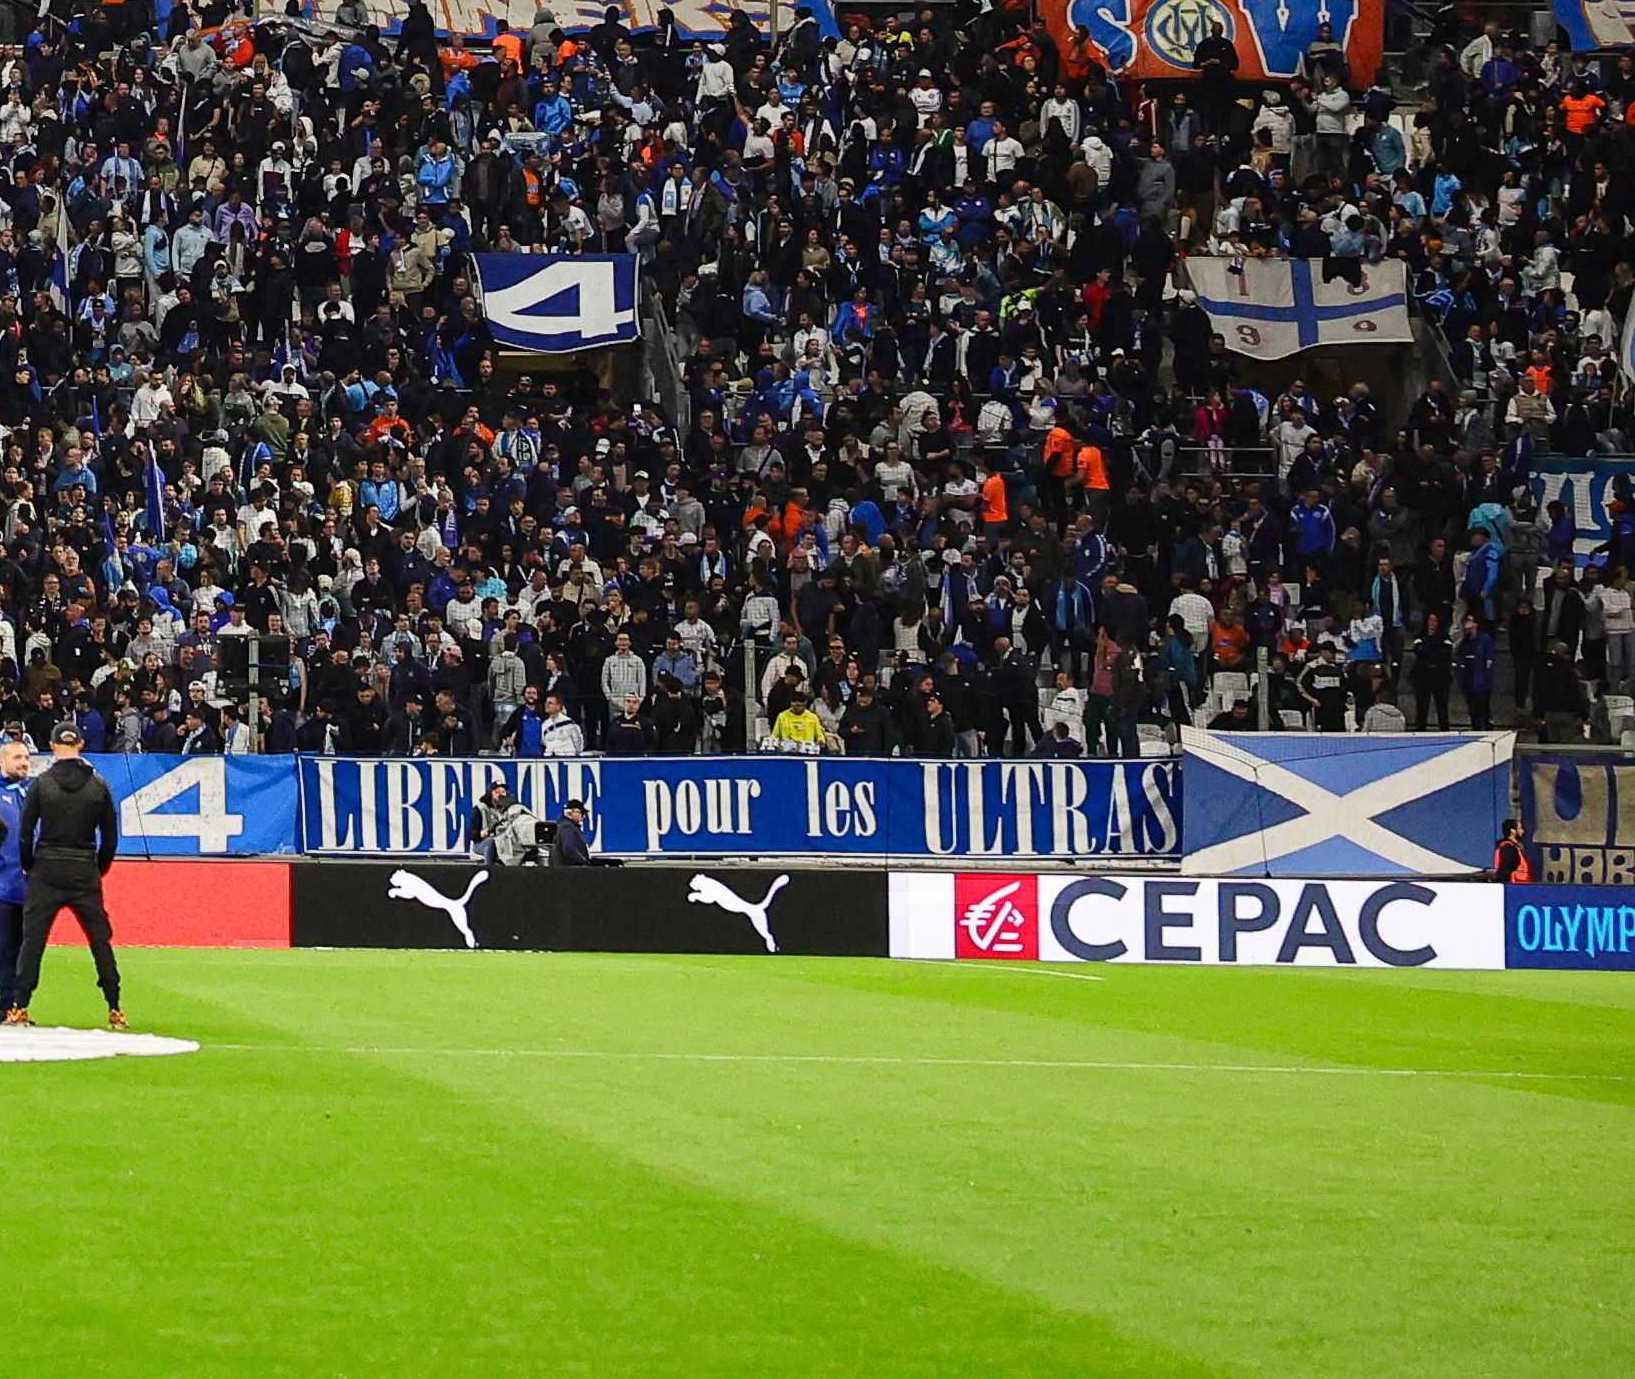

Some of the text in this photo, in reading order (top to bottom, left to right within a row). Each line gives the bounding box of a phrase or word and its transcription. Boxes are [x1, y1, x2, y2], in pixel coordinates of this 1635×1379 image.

[483, 259, 635, 341] 4
[642, 775, 763, 853] pour
[803, 760, 878, 838] les
[919, 762, 1178, 857] ULTRAS
[1049, 878, 1438, 967] CEPAC
